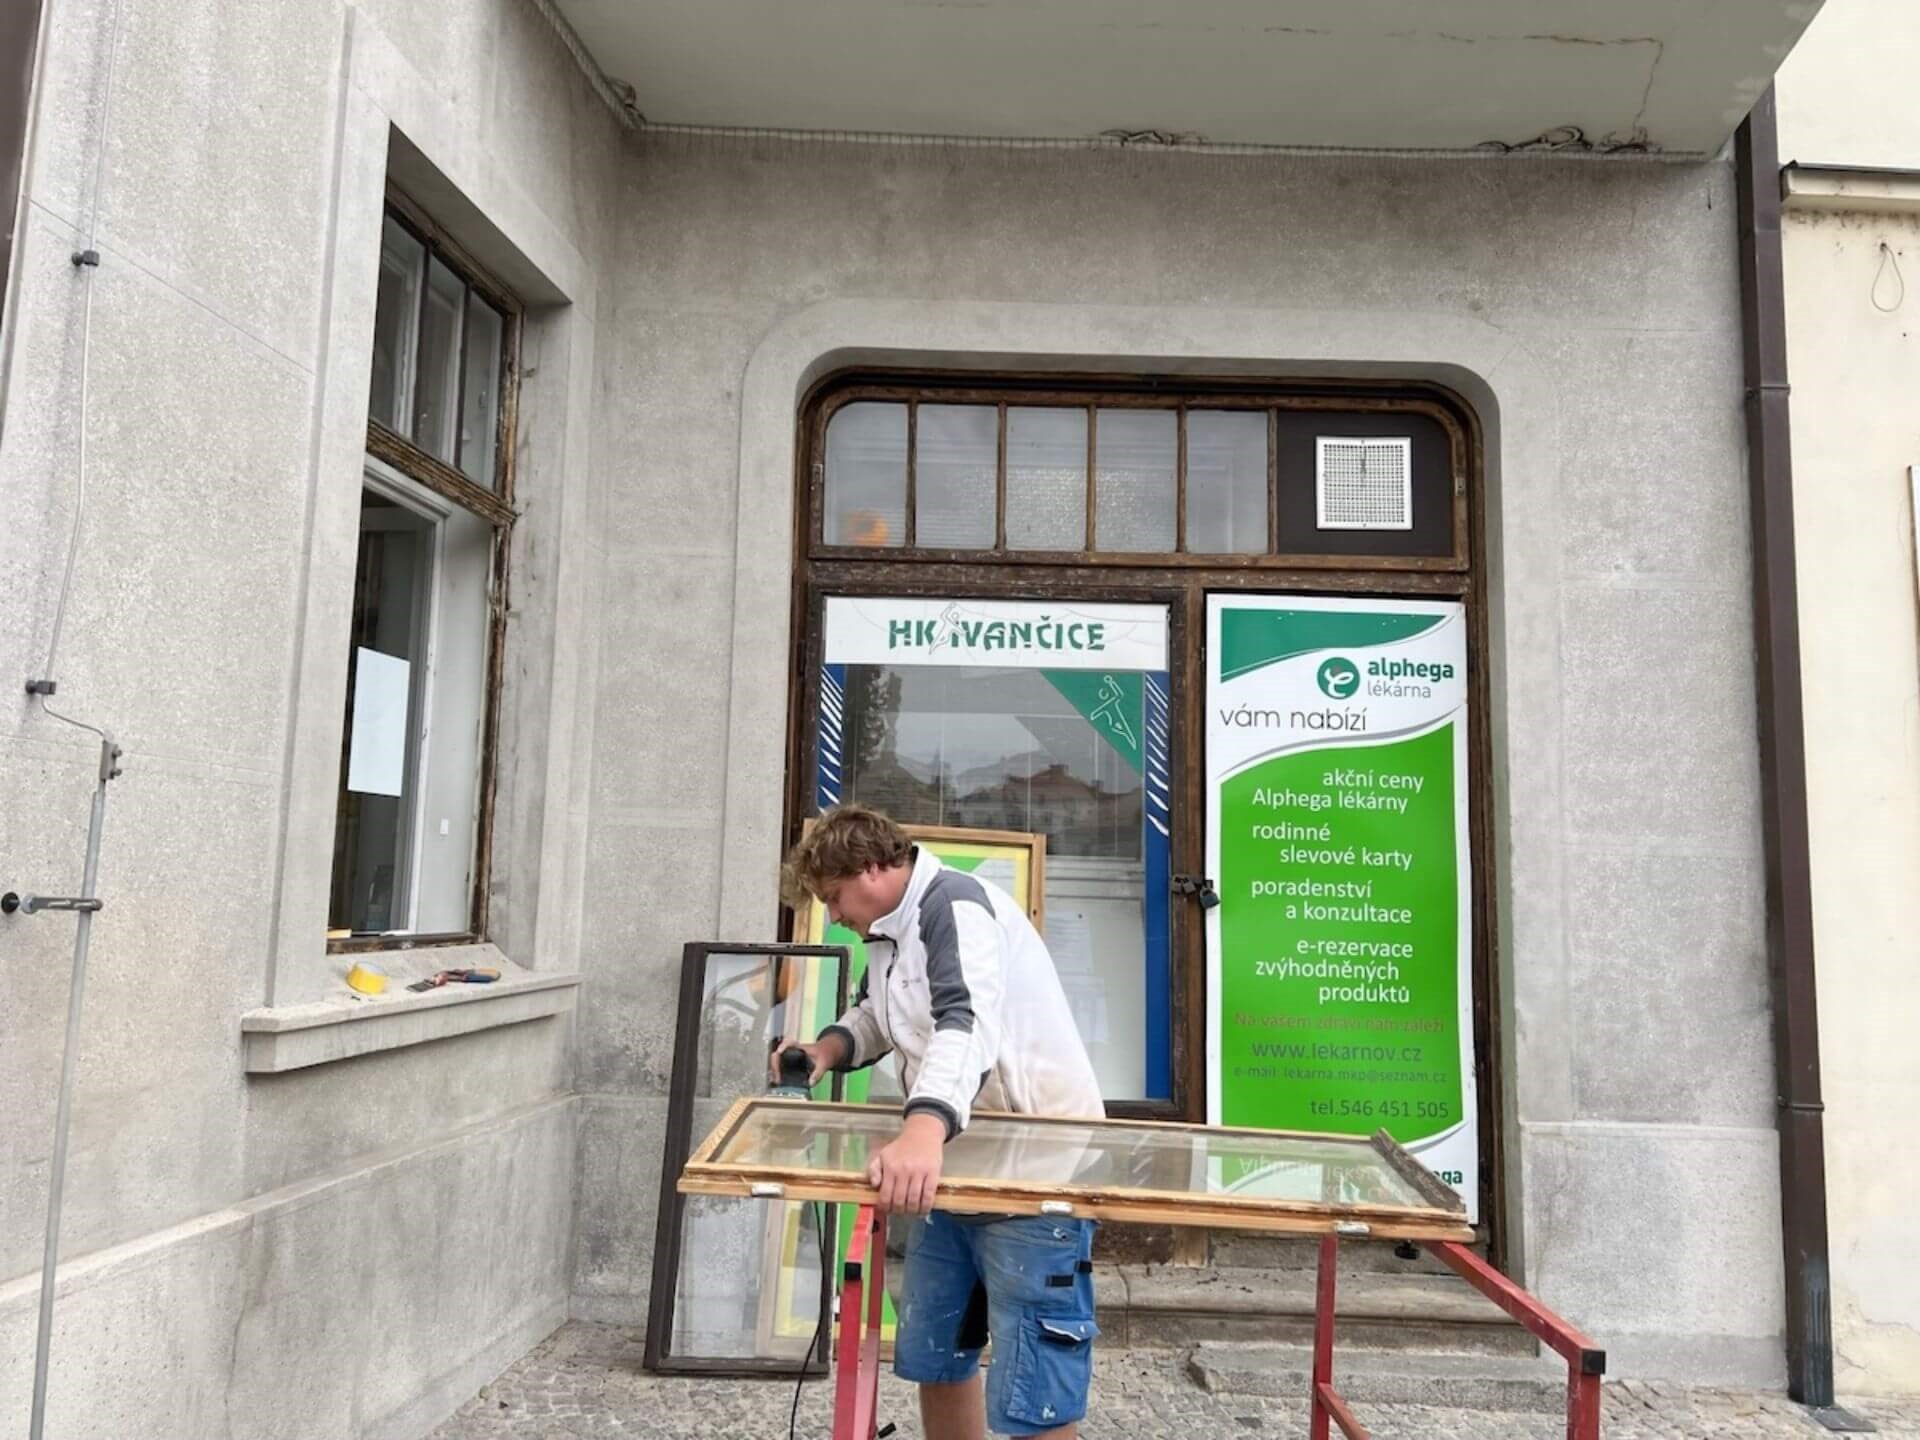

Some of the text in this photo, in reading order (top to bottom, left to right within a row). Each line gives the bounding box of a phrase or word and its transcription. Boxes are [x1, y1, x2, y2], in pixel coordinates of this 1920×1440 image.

[889, 615, 1105, 651] HK IVANČICE
[1367, 657, 1454, 683] alphega
[1367, 682, 1431, 698] lékárna
[1220, 702, 1367, 731] vám nabízí
[1322, 768, 1424, 796] akční ceny
[1252, 788, 1408, 814] Alphega lékárny
[1252, 822, 1331, 840] rodinné
[1280, 846, 1412, 870] slevové karty
[1251, 879, 1372, 898] poradenství
[1286, 902, 1412, 923] a konzultace
[1297, 939, 1413, 958] e-rezervace
[1255, 959, 1399, 981] zvýhodněných
[1319, 985, 1409, 1004] produktů
[1251, 1043, 1423, 1062] www.lekarnov.cz
[1311, 1100, 1449, 1118] tel.546 451 505
